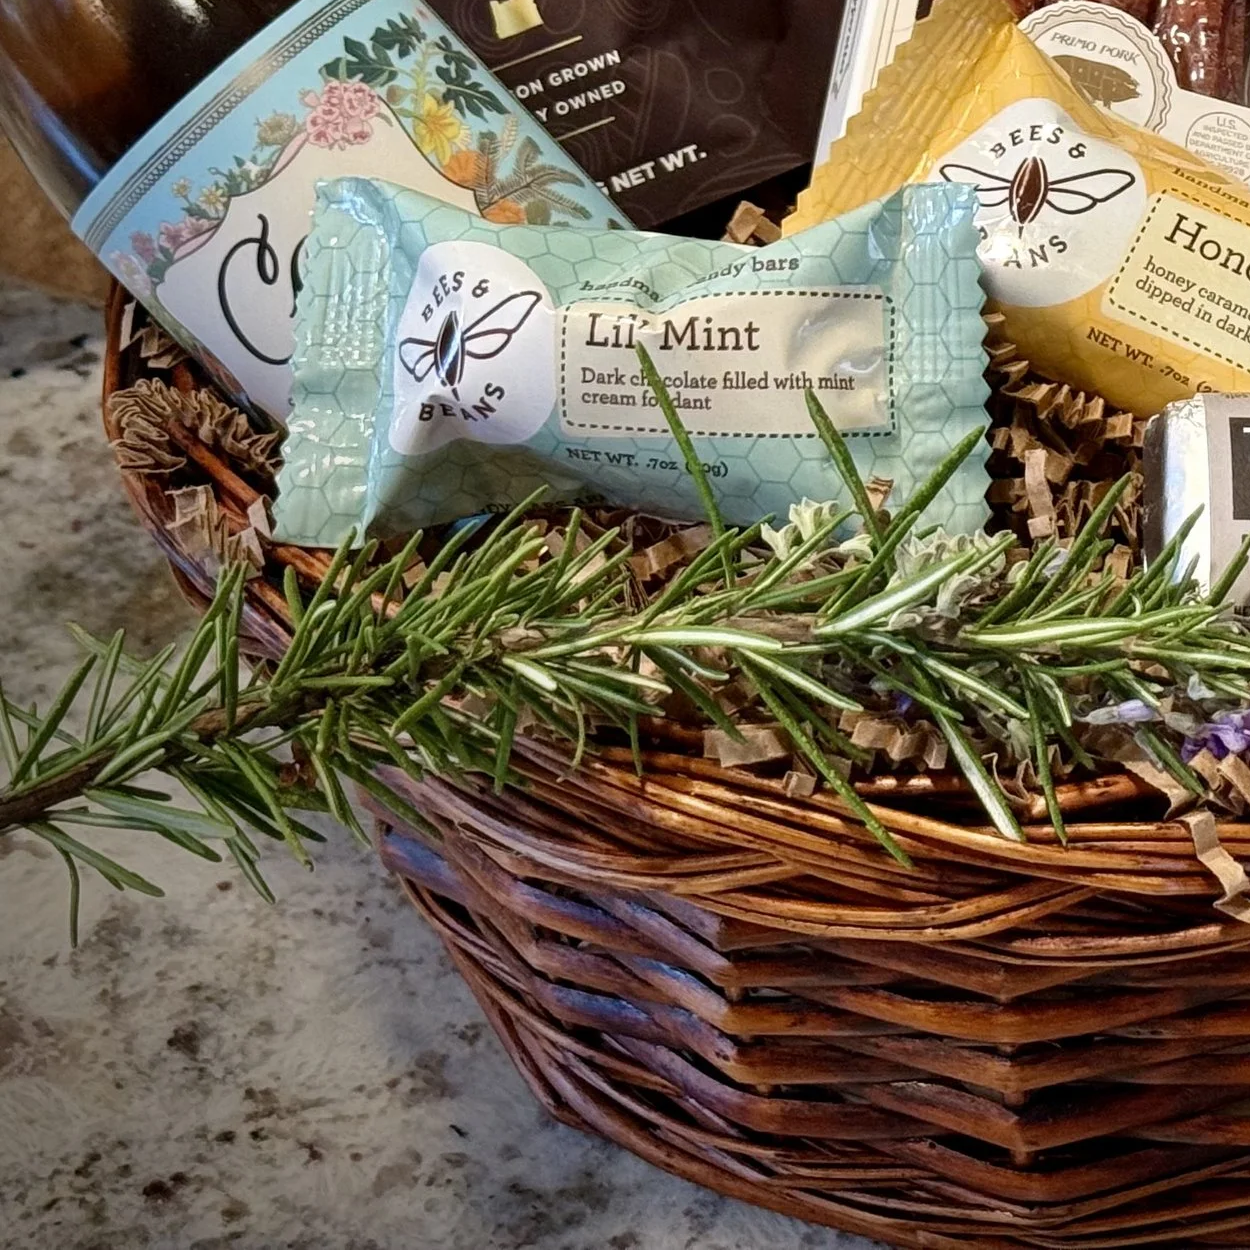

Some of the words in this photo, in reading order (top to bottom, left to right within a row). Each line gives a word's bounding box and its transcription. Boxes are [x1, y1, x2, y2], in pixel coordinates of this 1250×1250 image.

[1050, 32, 1097, 51] PRIMO
[1099, 45, 1140, 66] PORK
[549, 50, 621, 86] GROWN
[555, 80, 626, 115] OWNED
[990, 125, 1064, 158] BEES
[1068, 143, 1087, 159] &
[610, 161, 655, 193] NET
[659, 144, 707, 173] WT.
[752, 256, 800, 272] bars
[1143, 255, 1197, 293] honey
[421, 271, 465, 323] BEES
[472, 279, 490, 298] &
[1135, 276, 1195, 317] dipped
[1195, 304, 1213, 324] in
[659, 316, 761, 351] Mint
[1086, 326, 1123, 351] NET
[1124, 344, 1154, 369] WT.
[1160, 364, 1190, 386] .7oz
[581, 367, 626, 385] Dark
[630, 368, 718, 390] chcolate
[723, 371, 769, 390] filled
[774, 371, 813, 390] with
[818, 373, 855, 391] mint
[419, 382, 505, 422] BEANS
[581, 392, 637, 406] cream
[642, 390, 712, 411] fodant
[565, 447, 602, 462] NET
[607, 452, 640, 467] WT.
[646, 458, 678, 470] .7oz
